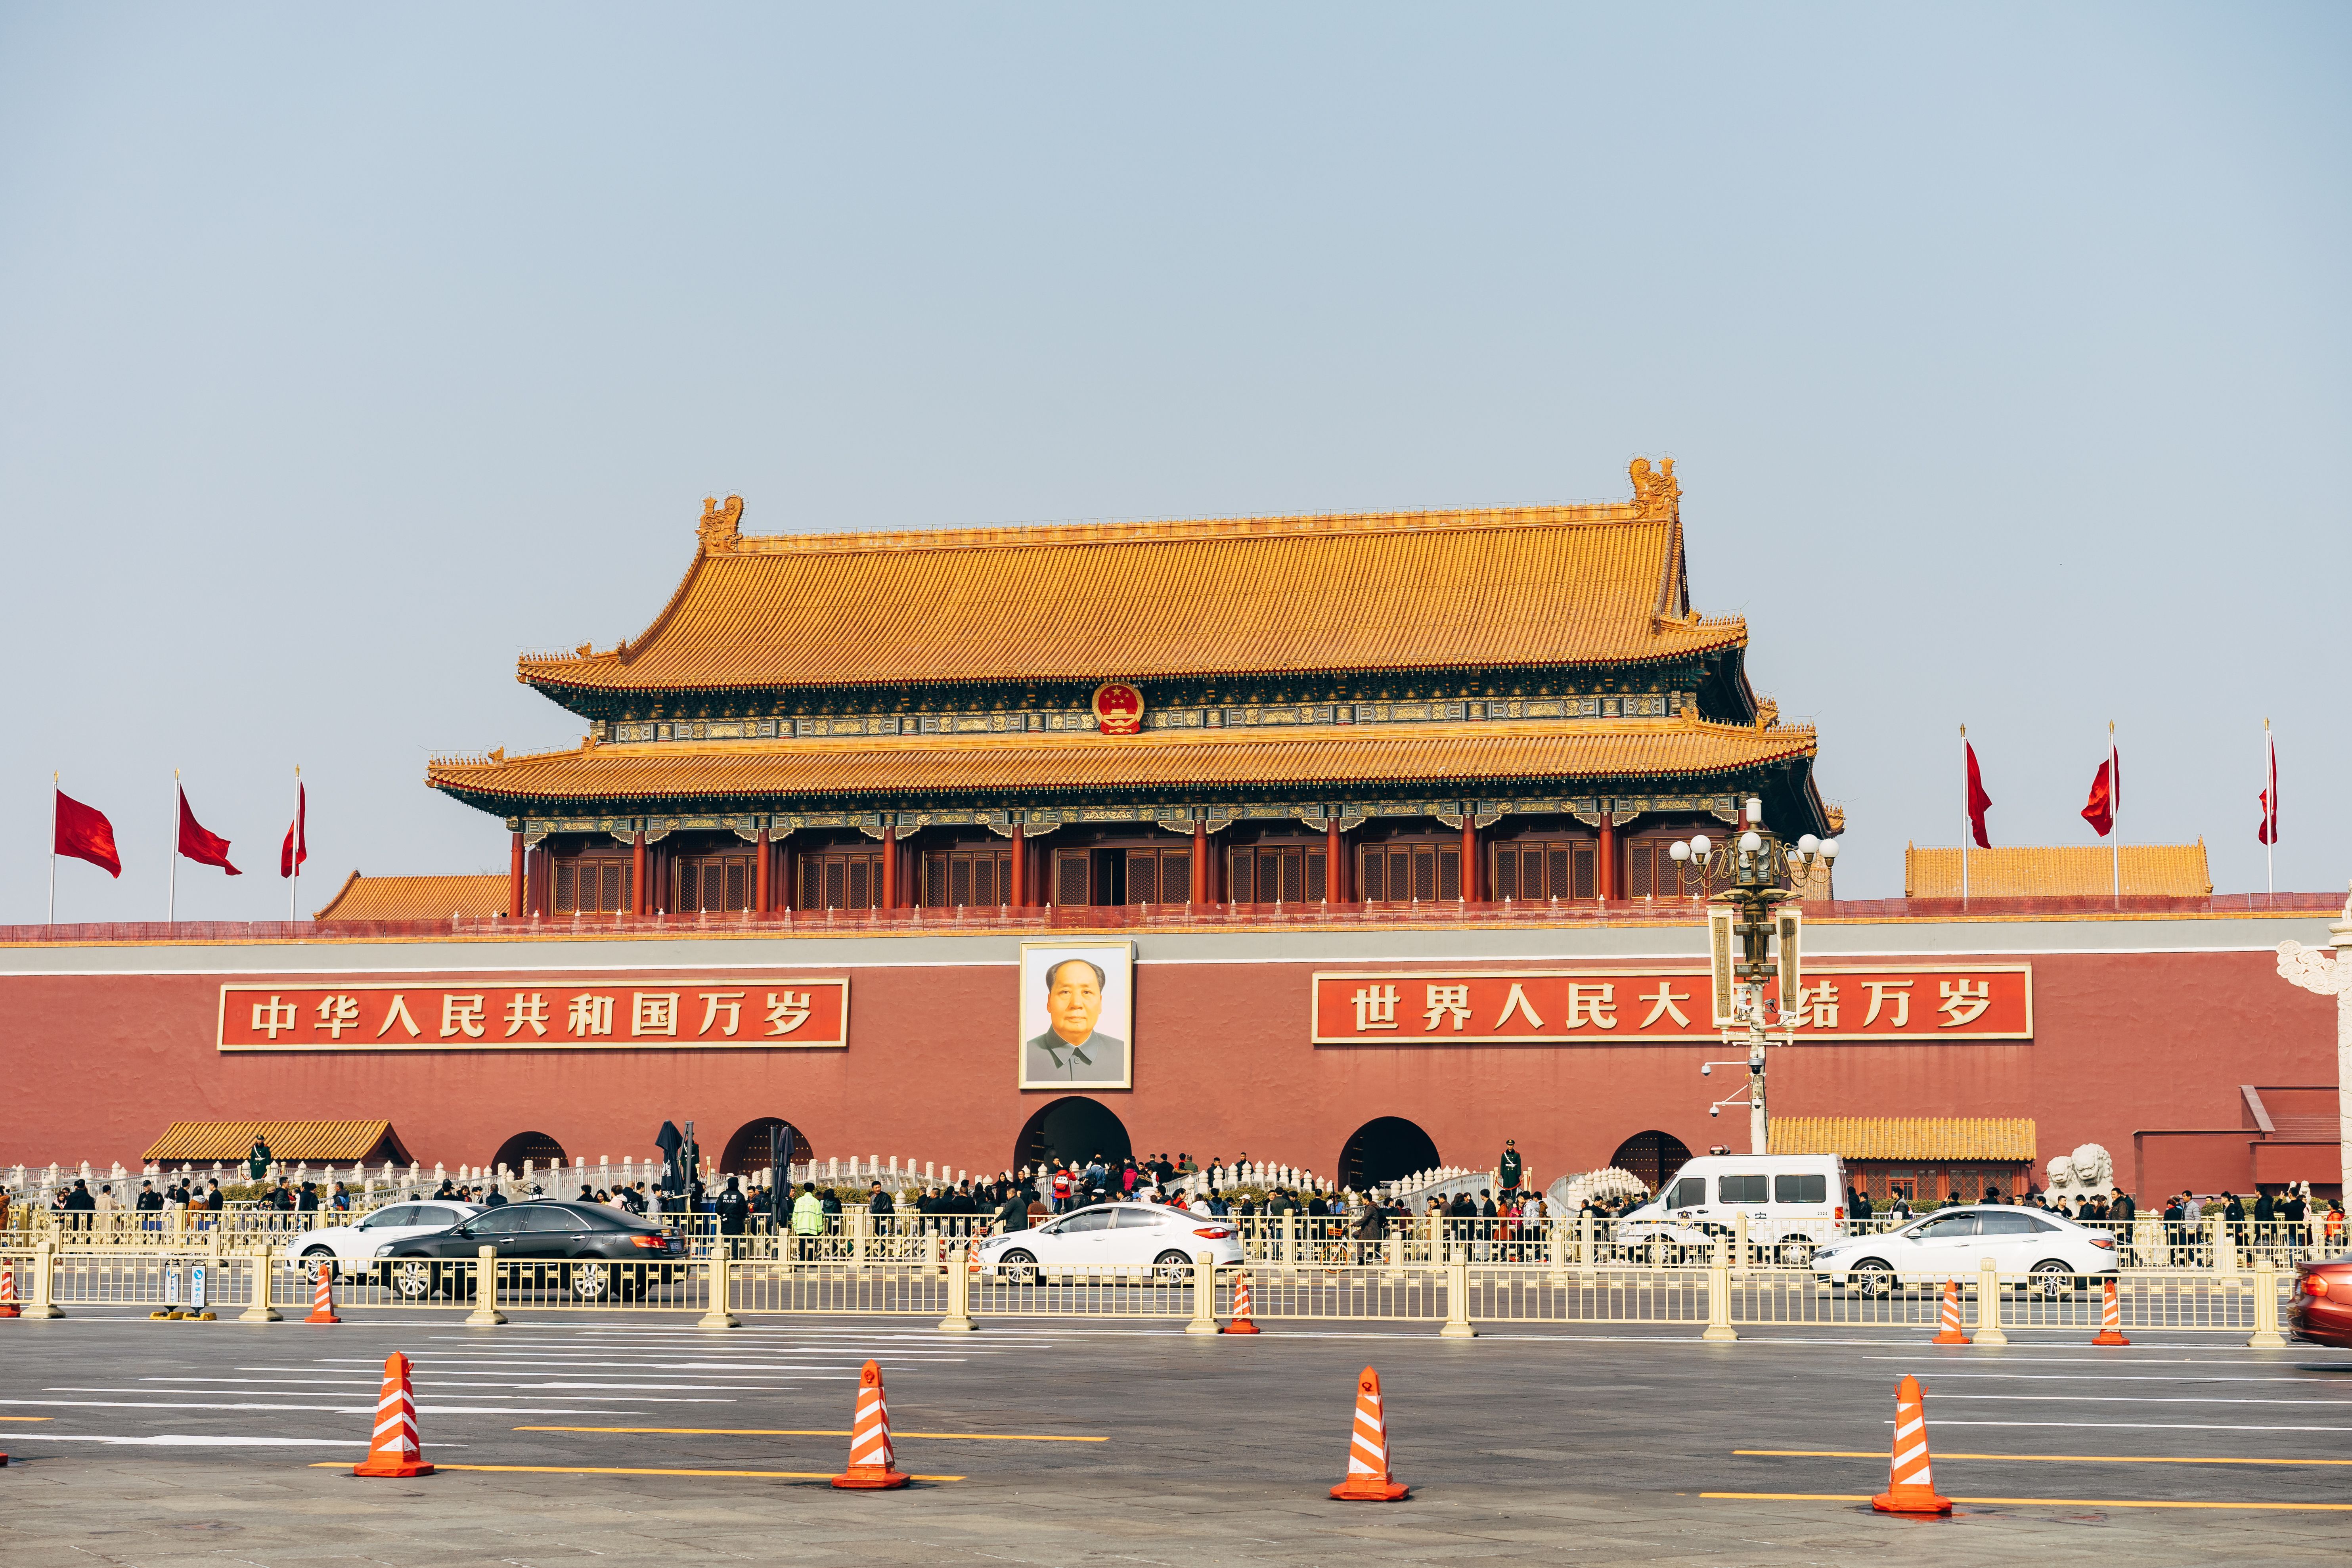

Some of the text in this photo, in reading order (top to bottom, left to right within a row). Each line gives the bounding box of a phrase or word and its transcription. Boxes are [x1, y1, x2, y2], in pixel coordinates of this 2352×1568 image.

[252, 991, 811, 1038] 中华人民共和国万岁
